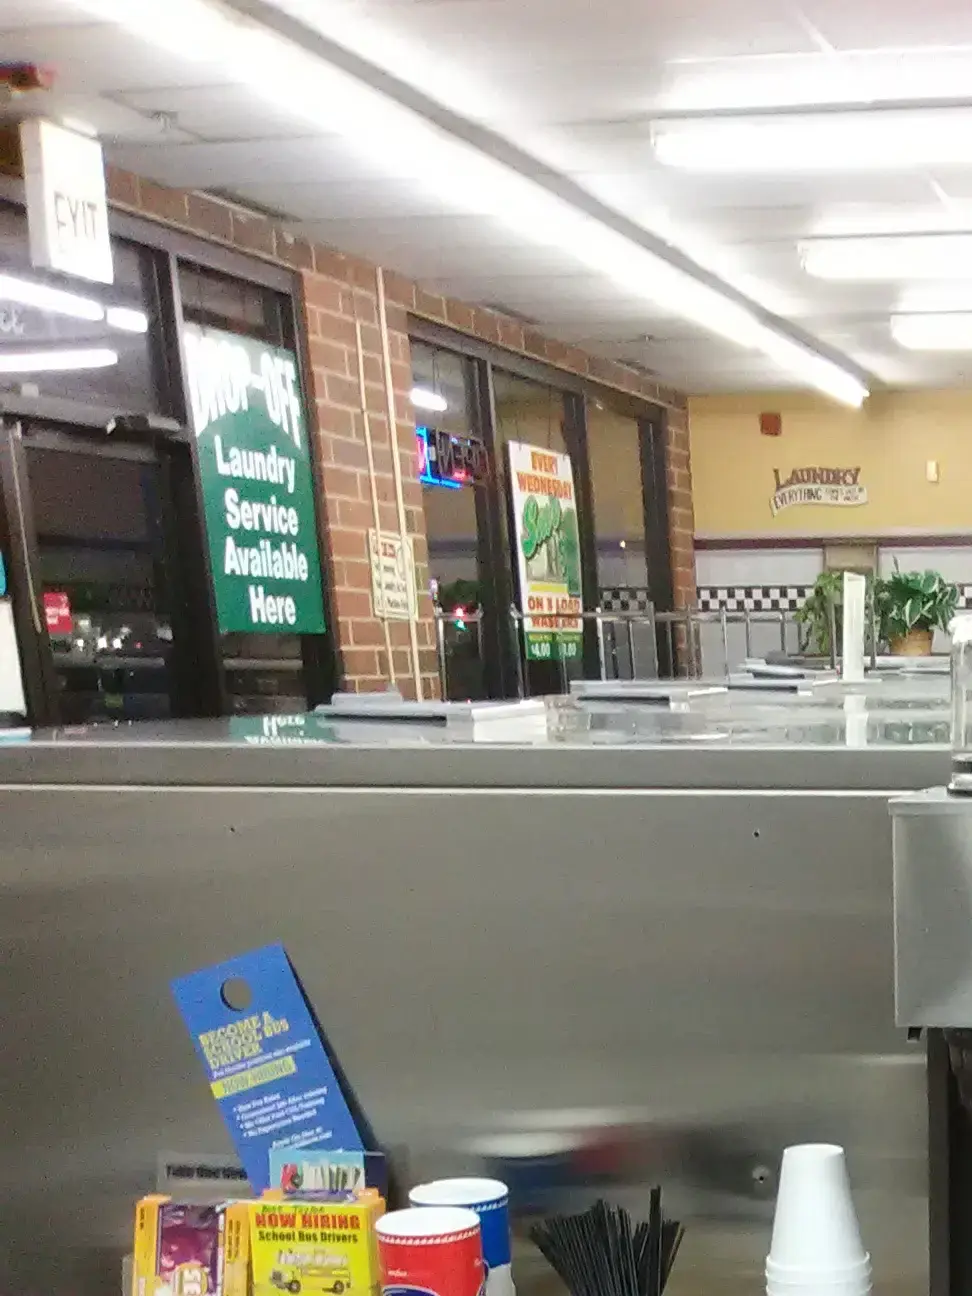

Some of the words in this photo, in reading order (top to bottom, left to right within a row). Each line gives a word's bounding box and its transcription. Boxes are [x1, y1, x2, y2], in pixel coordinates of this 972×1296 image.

[214, 434, 295, 494] Laundry
[772, 466, 861, 492] LAUNDRY
[224, 488, 299, 537] Service
[224, 535, 308, 581] Available
[249, 585, 296, 625] Here
[255, 1213, 297, 1228] NOW
[302, 1213, 360, 1229] HIRING
[258, 1230, 295, 1242] School
[298, 1231, 318, 1242] Bus
[320, 1231, 358, 1243] Drivers
